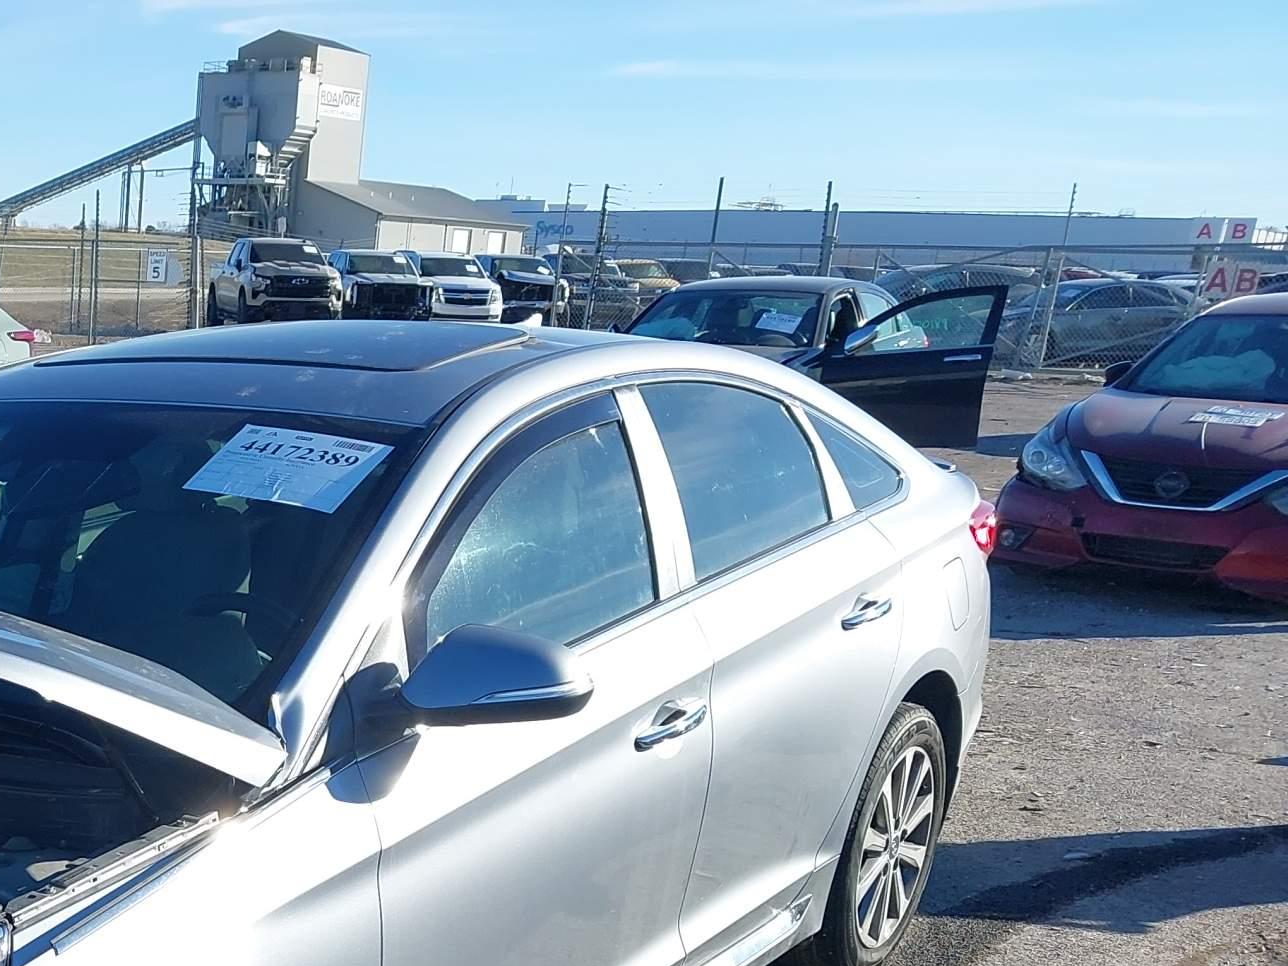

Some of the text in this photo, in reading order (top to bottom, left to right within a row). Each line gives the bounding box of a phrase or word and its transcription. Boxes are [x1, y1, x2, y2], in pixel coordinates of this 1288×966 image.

[320, 90, 361, 107] ROANOKE
[1196, 223, 1247, 239] A B
[152, 266, 161, 279] 5
[1204, 267, 1257, 293] A B
[240, 440, 360, 467] 44172389
